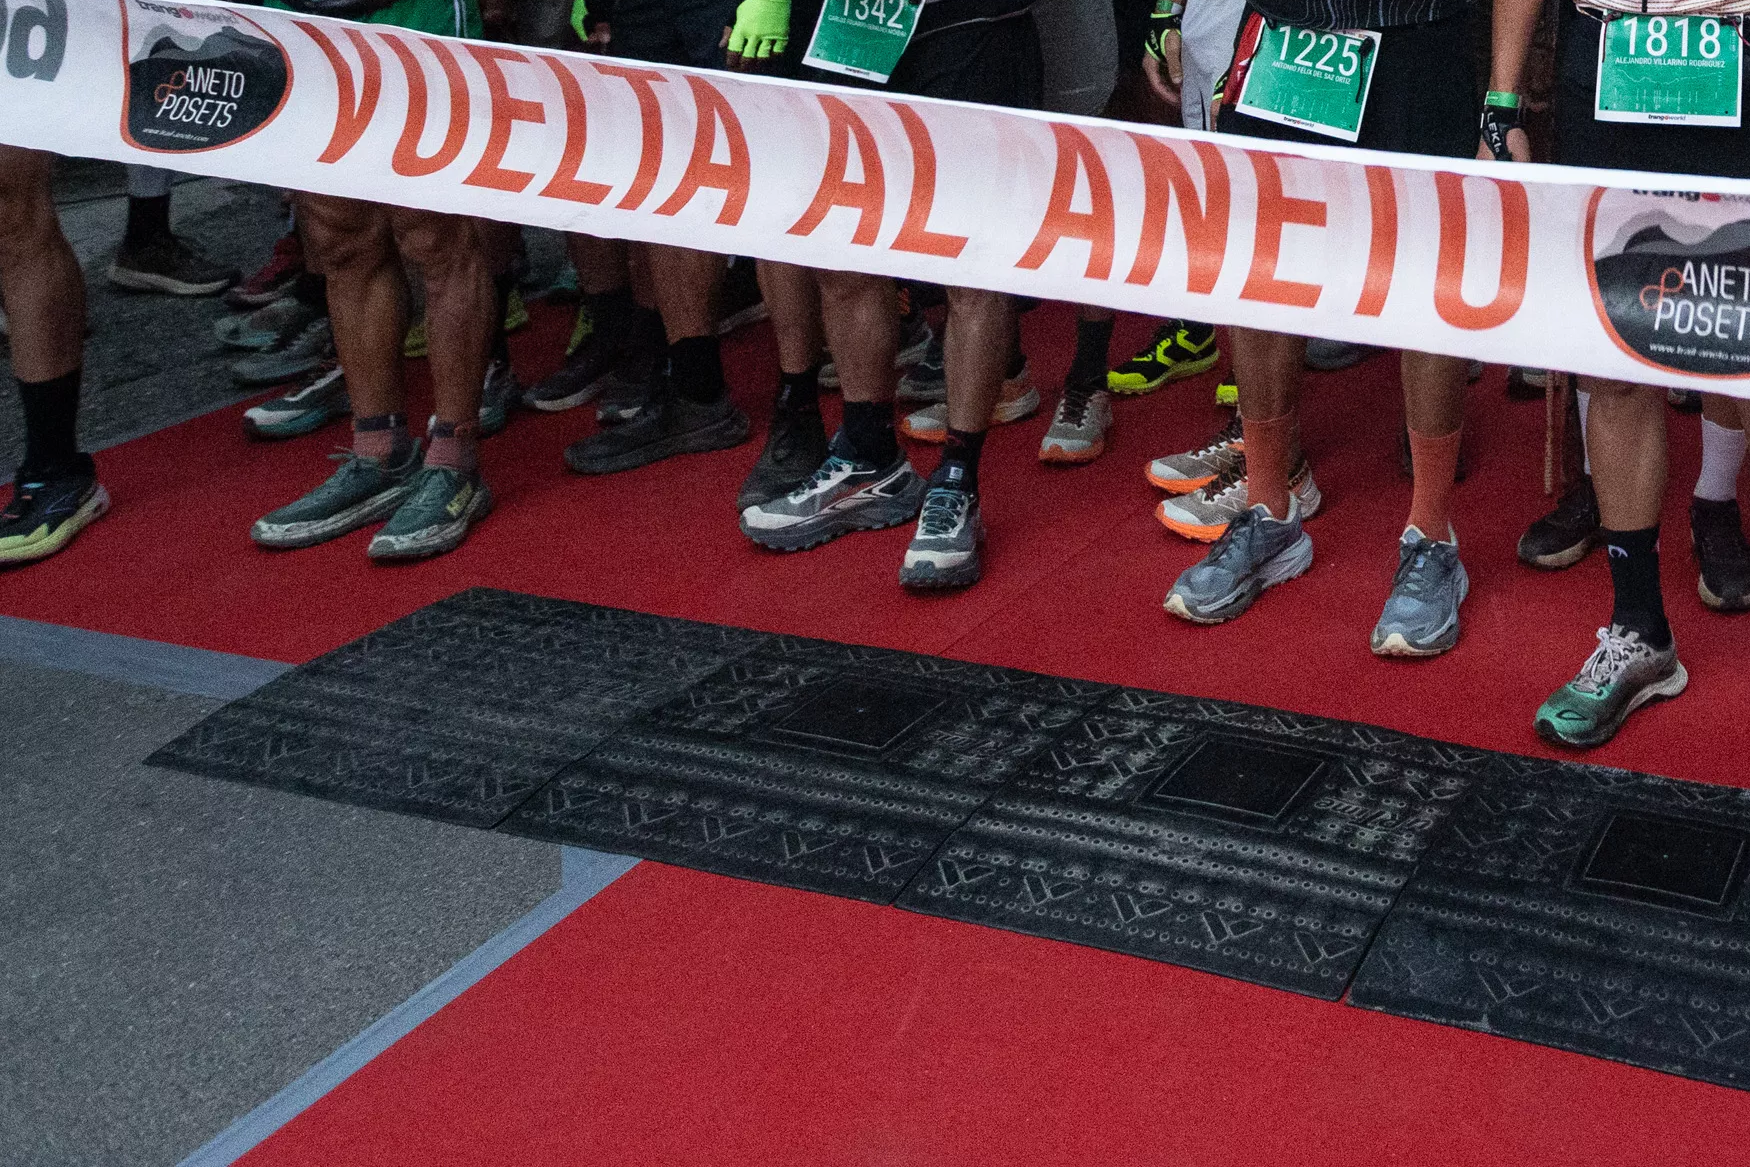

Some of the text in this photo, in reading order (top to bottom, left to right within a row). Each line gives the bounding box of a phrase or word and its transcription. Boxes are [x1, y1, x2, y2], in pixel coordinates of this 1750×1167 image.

[1278, 25, 1362, 77] 1225
[1623, 16, 1721, 59] 1818
[1272, 61, 1296, 73] ANTONIO
[1615, 56, 1652, 66] ALEJANDRO
[1653, 57, 1688, 67] VILLARINO
[186, 65, 245, 99] ANETO
[155, 93, 237, 128] POSETS
[1486, 111, 1502, 148] LEKI
[290, 20, 1531, 331] VUELTA AL ANETO
